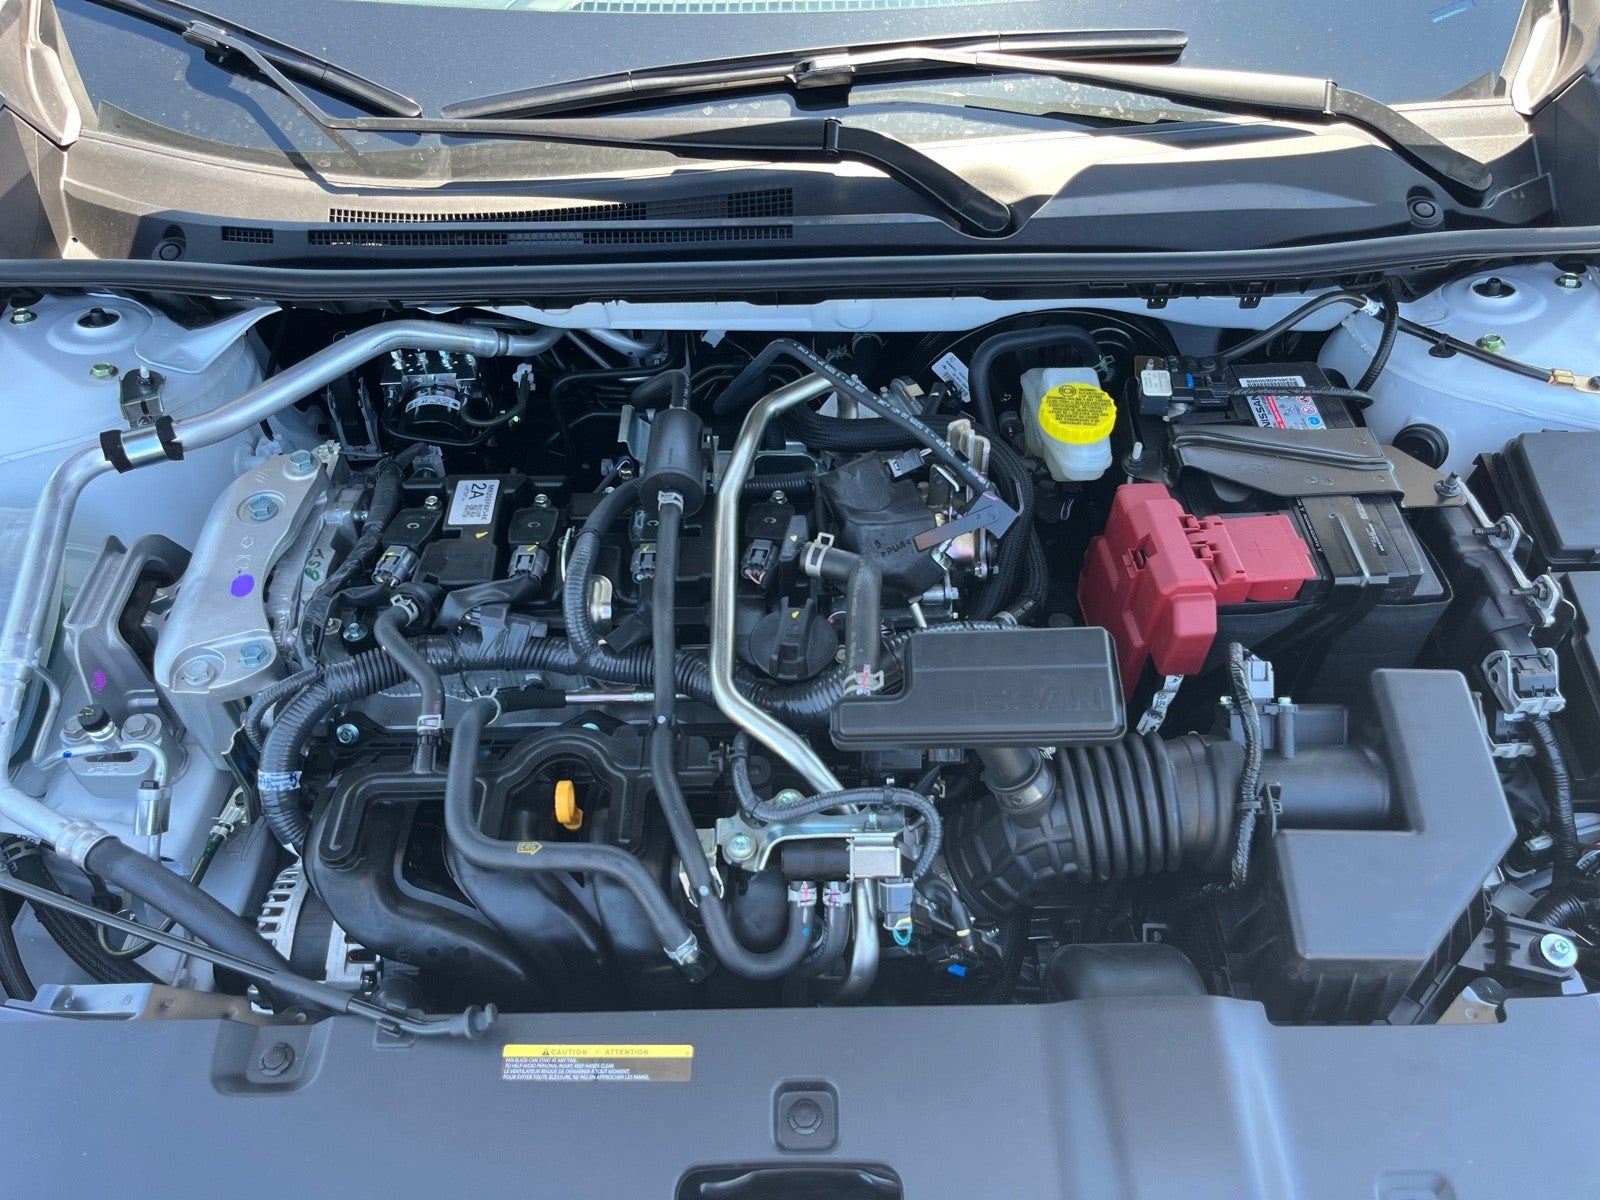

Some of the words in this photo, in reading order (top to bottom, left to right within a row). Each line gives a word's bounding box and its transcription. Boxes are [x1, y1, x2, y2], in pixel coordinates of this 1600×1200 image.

[469, 483, 487, 500] 2A
[550, 1048, 587, 1056] CAUTION
[604, 1048, 649, 1056] ATTENTION
